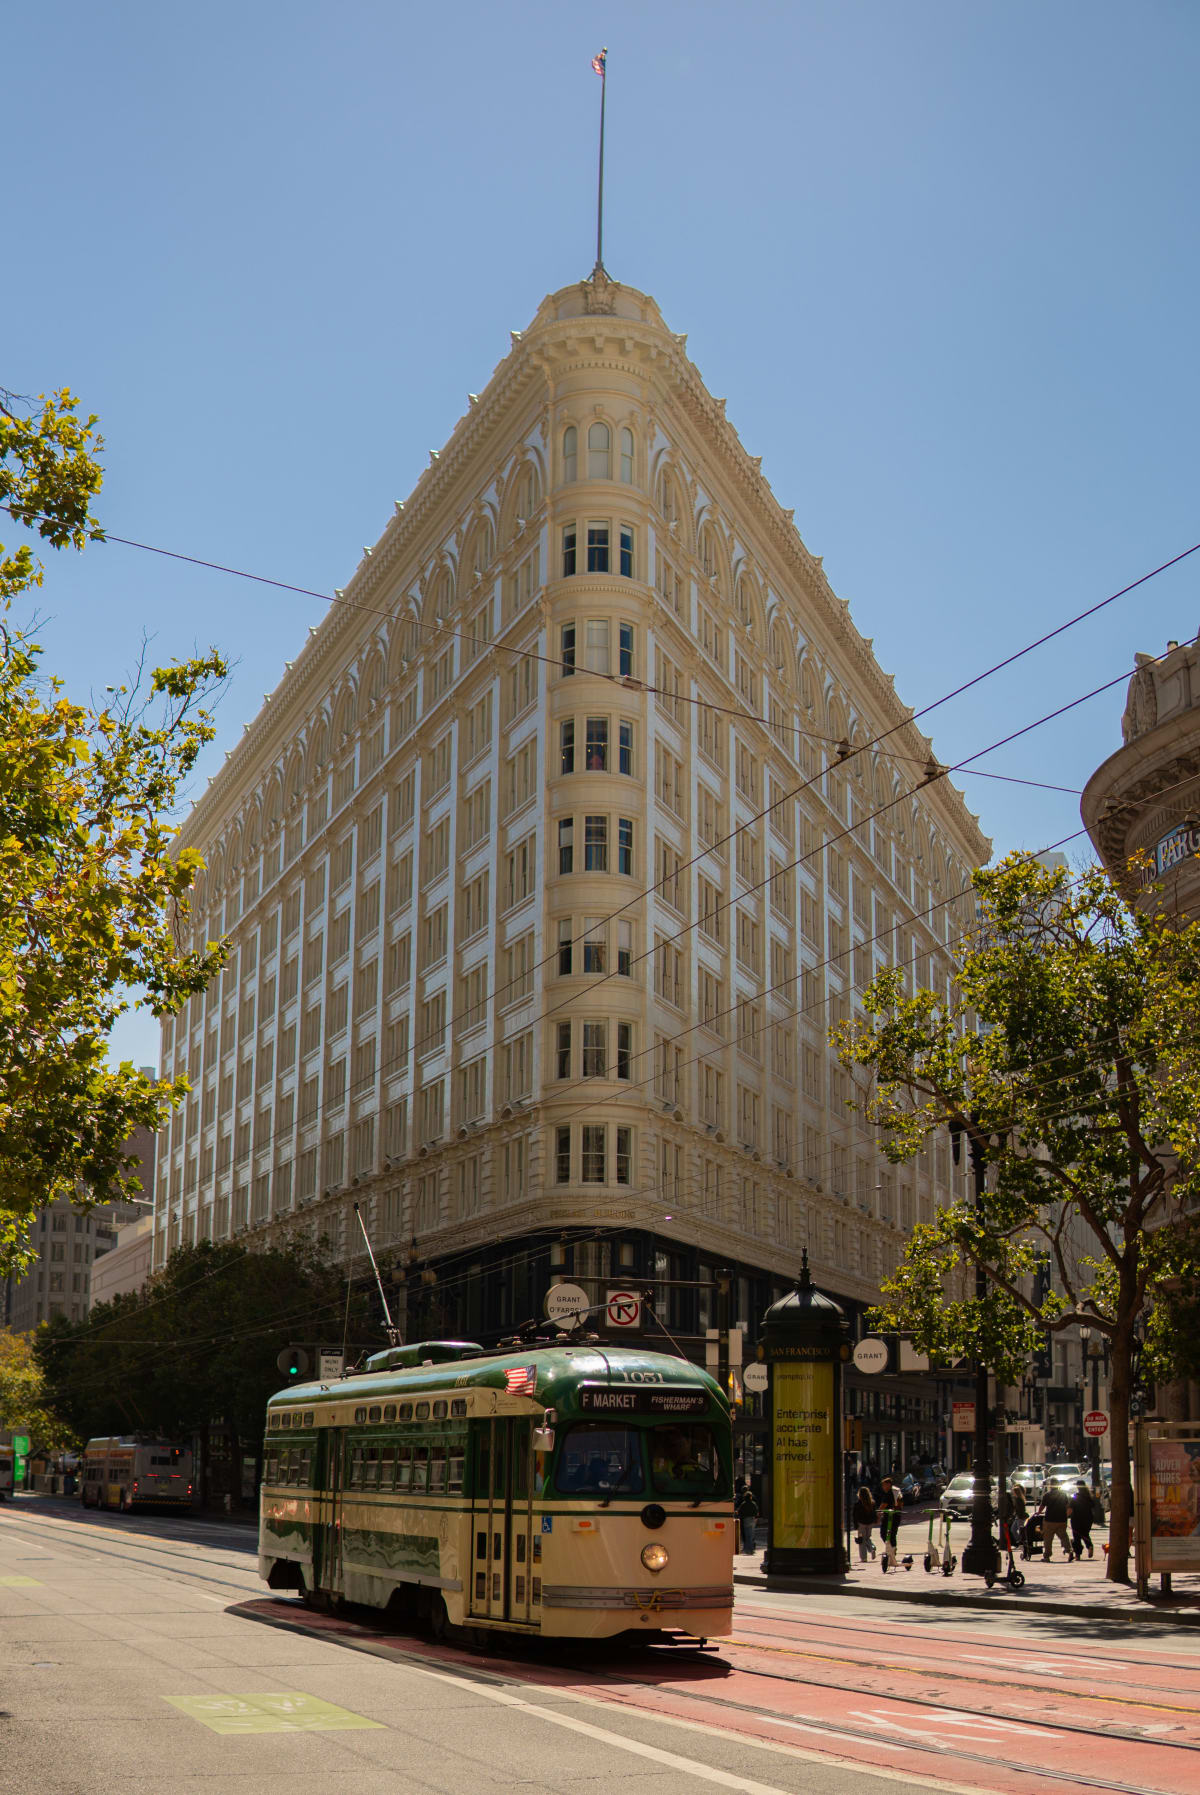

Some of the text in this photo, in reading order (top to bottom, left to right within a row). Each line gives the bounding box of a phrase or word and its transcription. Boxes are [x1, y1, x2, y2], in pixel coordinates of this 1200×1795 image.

[770, 1347, 831, 1356] SAN FRANCISCO
[621, 1371, 667, 1384] 1051
[582, 1393, 637, 1408] F MARKET
[651, 1395, 704, 1405] FISHERMAN'S
[663, 1403, 691, 1411] WHARF
[776, 1409, 828, 1421] Enterprise
[776, 1424, 822, 1433] accurate
[776, 1437, 809, 1447] AI has
[776, 1451, 815, 1461] arrived.
[1155, 1472, 1182, 1484] TURES
[1166, 1485, 1181, 1504] AI
